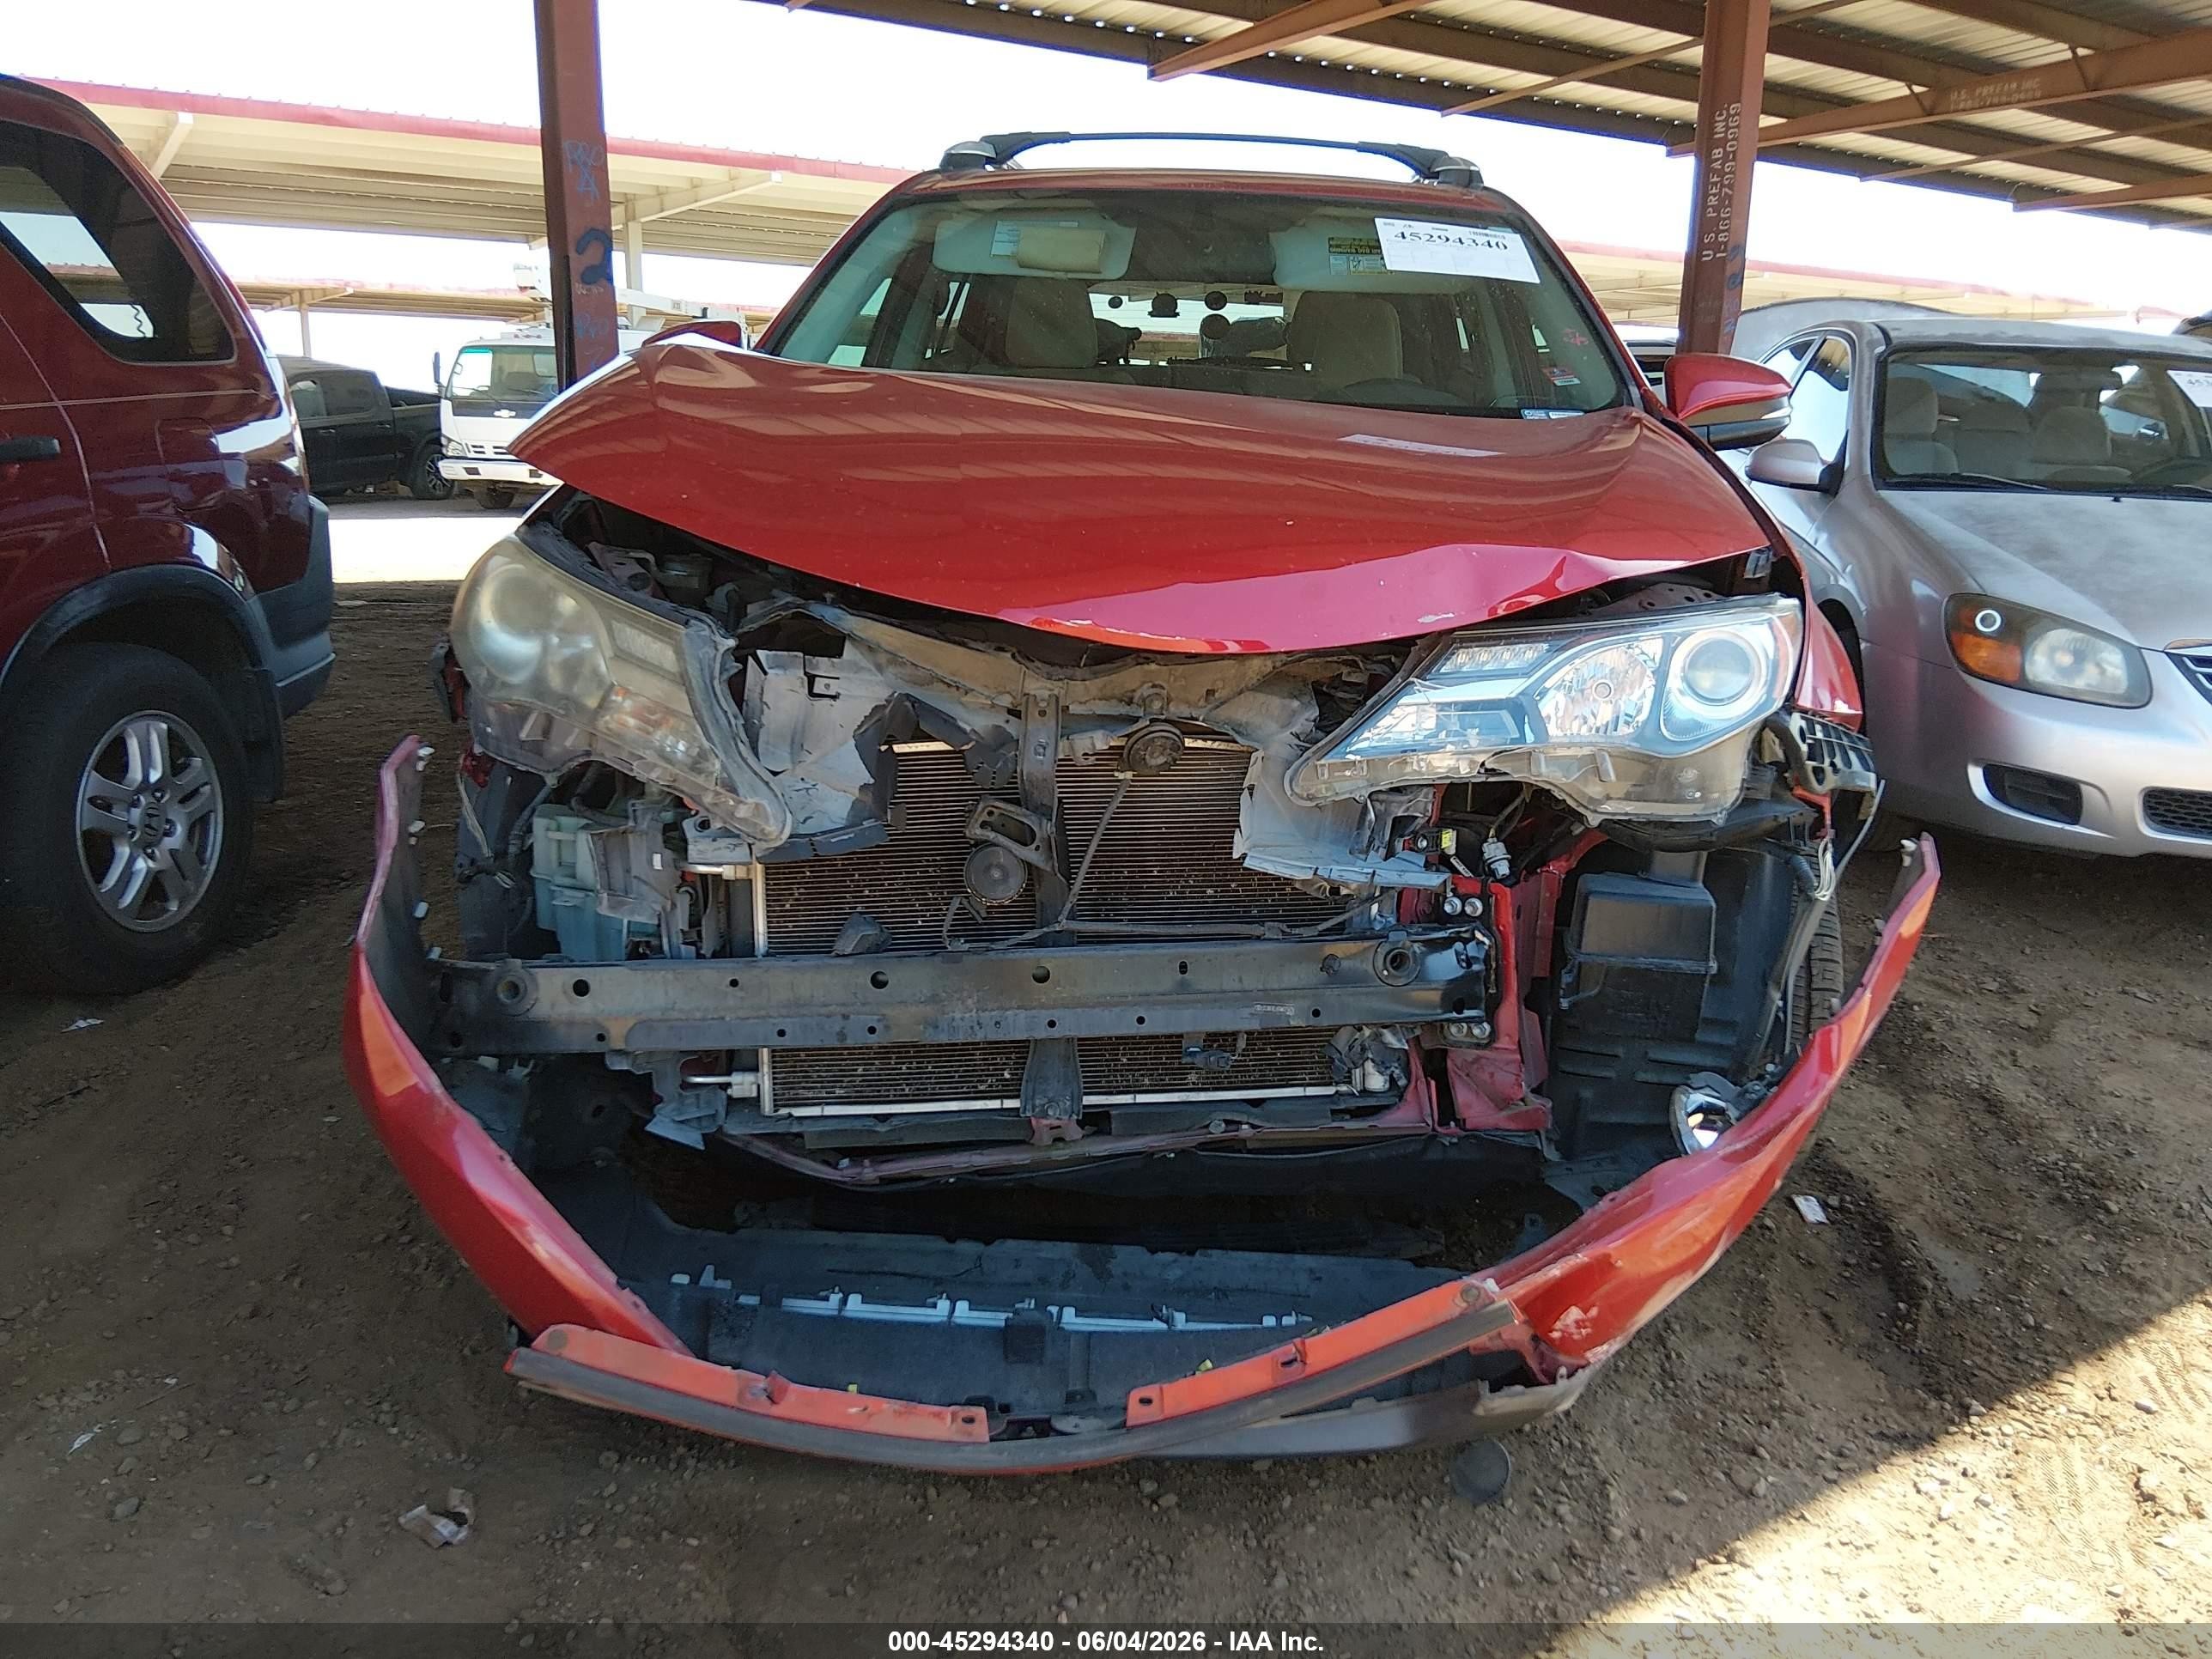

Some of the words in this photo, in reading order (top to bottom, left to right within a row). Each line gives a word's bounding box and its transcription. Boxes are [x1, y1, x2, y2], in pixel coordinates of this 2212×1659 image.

[1712, 102, 1729, 138] INC.
[1706, 147, 1724, 217] PREFAB
[1716, 102, 1741, 258] 1-866-799-0969
[1394, 230, 1509, 251] 45294340
